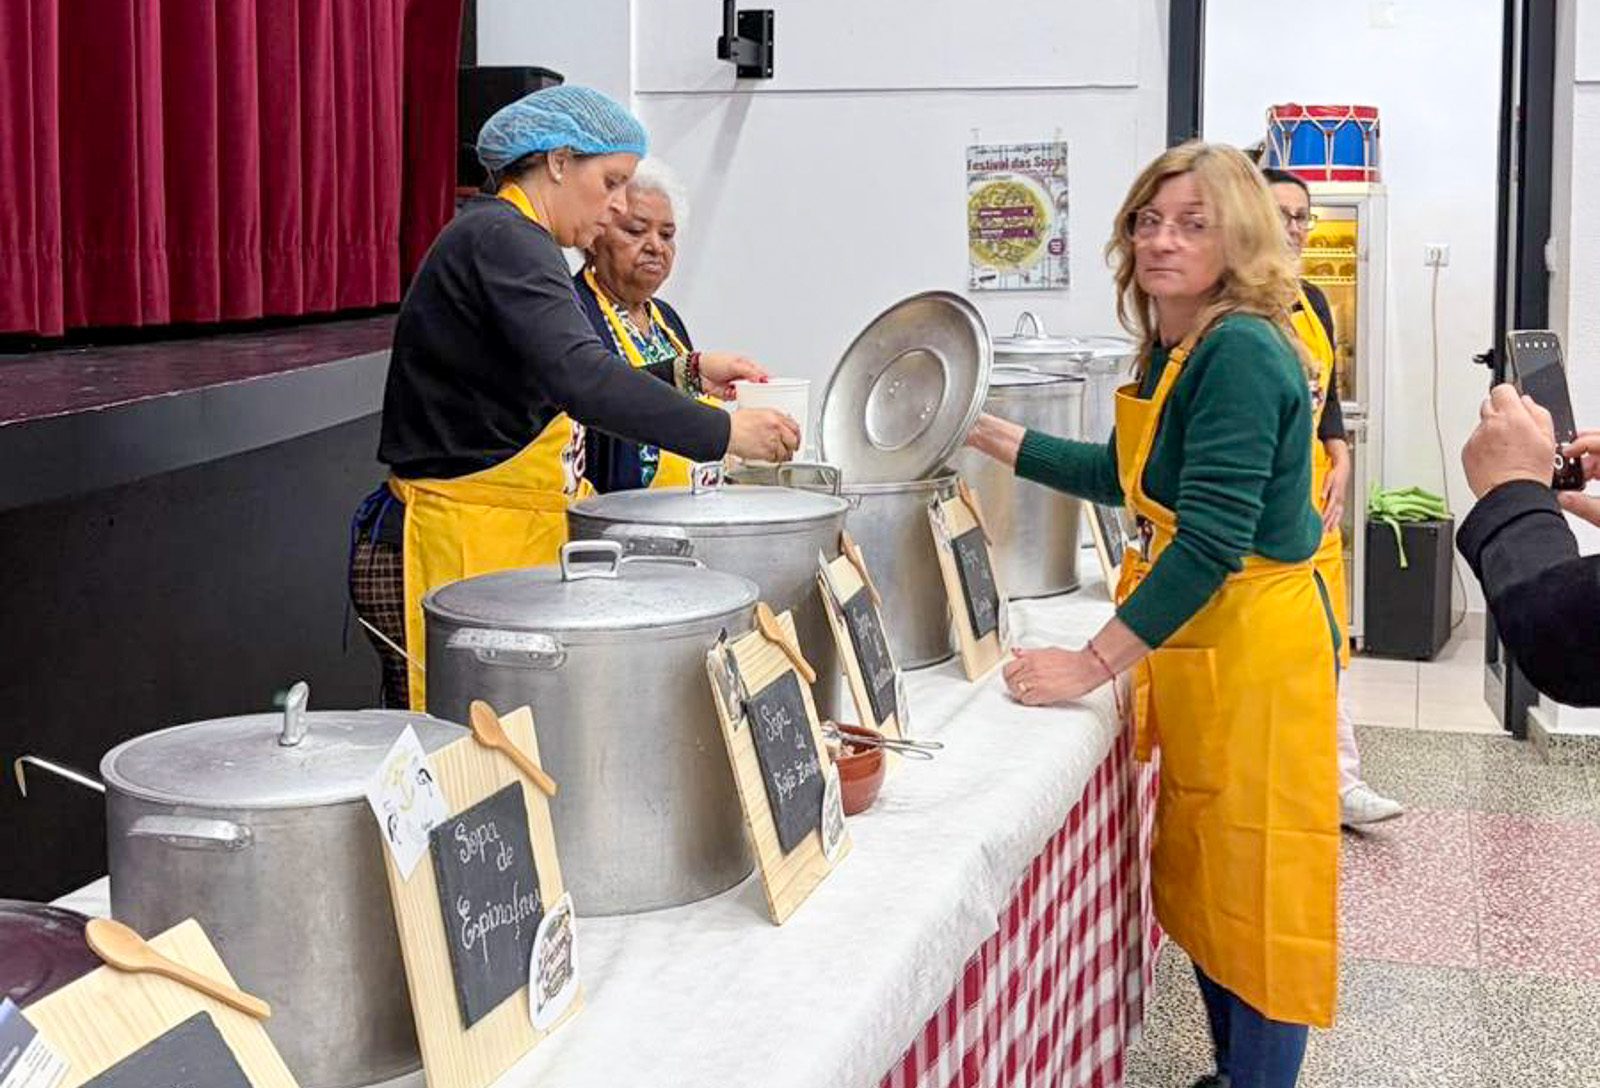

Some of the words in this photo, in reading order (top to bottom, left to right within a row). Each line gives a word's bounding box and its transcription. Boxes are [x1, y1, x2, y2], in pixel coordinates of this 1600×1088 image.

[967, 158, 1008, 171] Festival
[1012, 157, 1031, 169] das
[455, 822, 500, 864] Sopa
[496, 841, 513, 871] de
